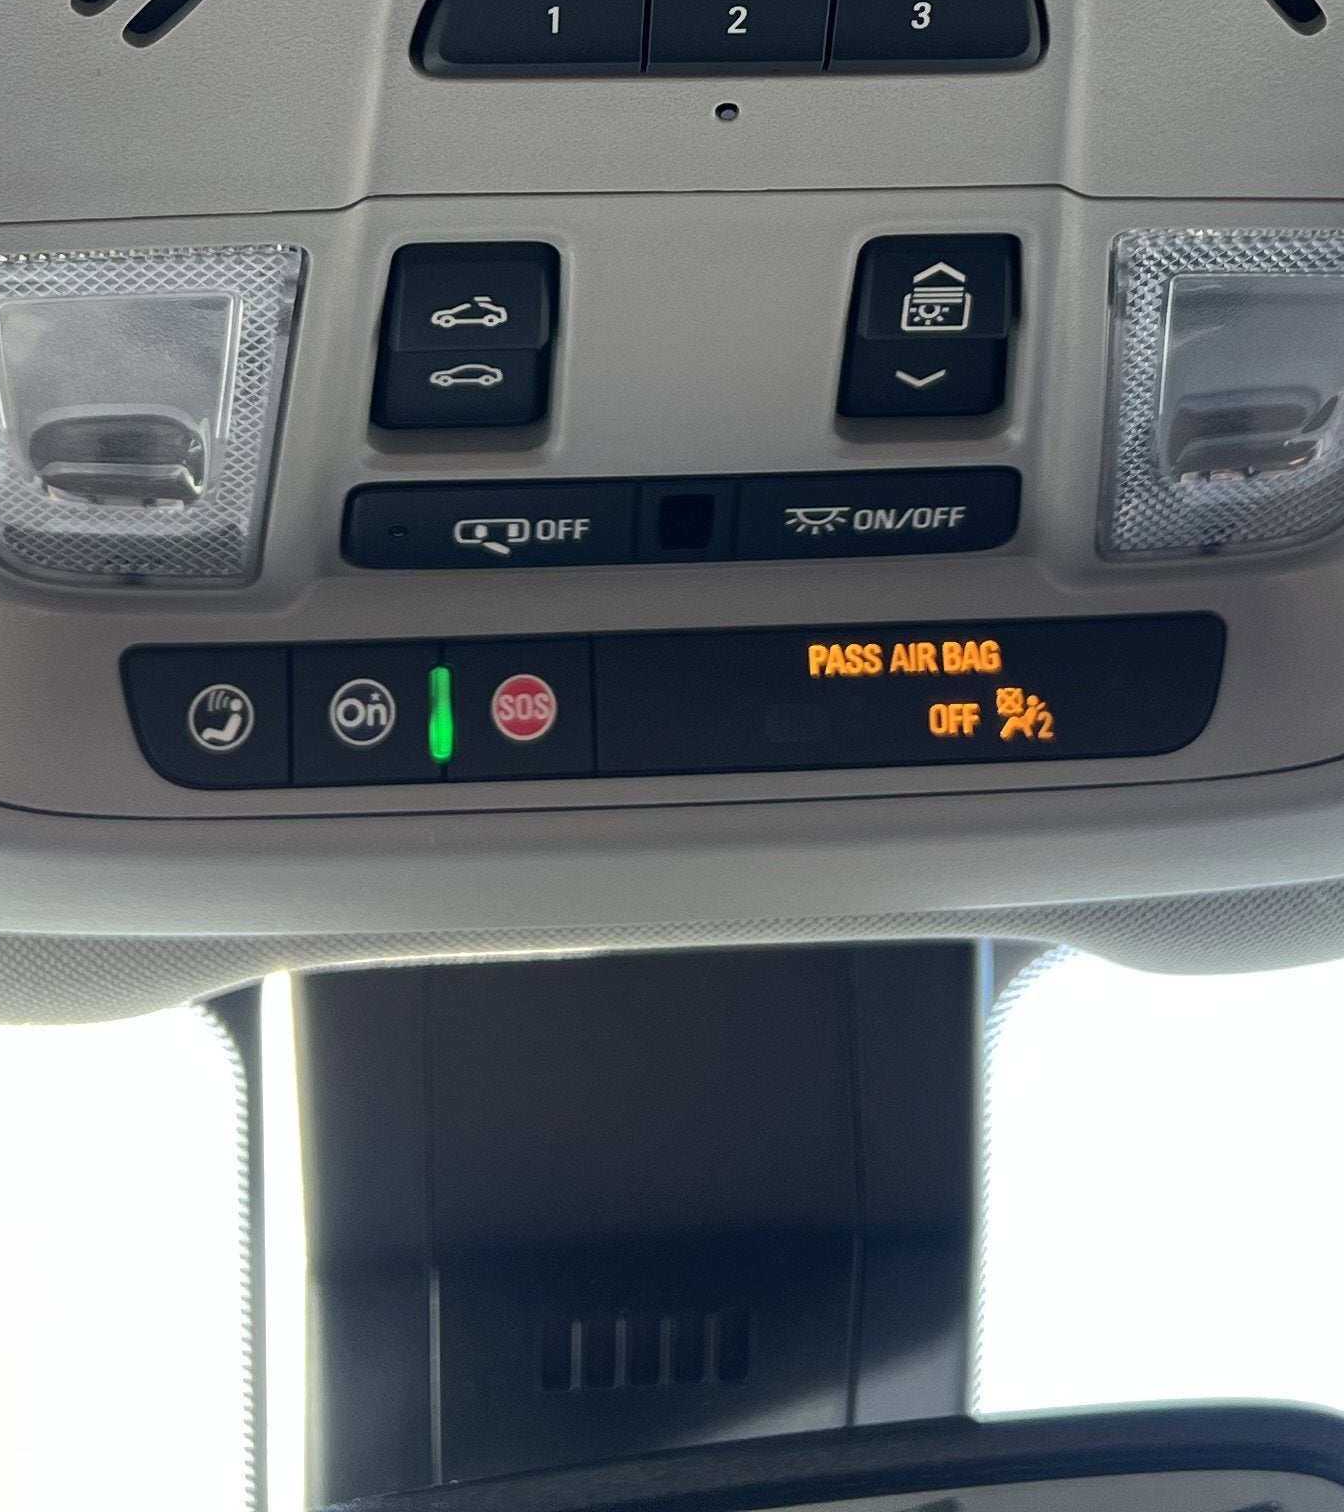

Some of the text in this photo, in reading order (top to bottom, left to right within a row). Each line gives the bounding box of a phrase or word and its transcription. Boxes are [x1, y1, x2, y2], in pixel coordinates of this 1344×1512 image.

[547, 6, 561, 35] 1
[726, 6, 749, 35] 2
[910, 1, 932, 30] 3
[535, 517, 591, 542] OFF
[853, 505, 967, 532] ON/OFF
[807, 639, 1002, 677] PASS AIR BAG
[336, 697, 388, 728] On
[499, 692, 550, 721] SOS
[928, 702, 1055, 741] OFF 2
